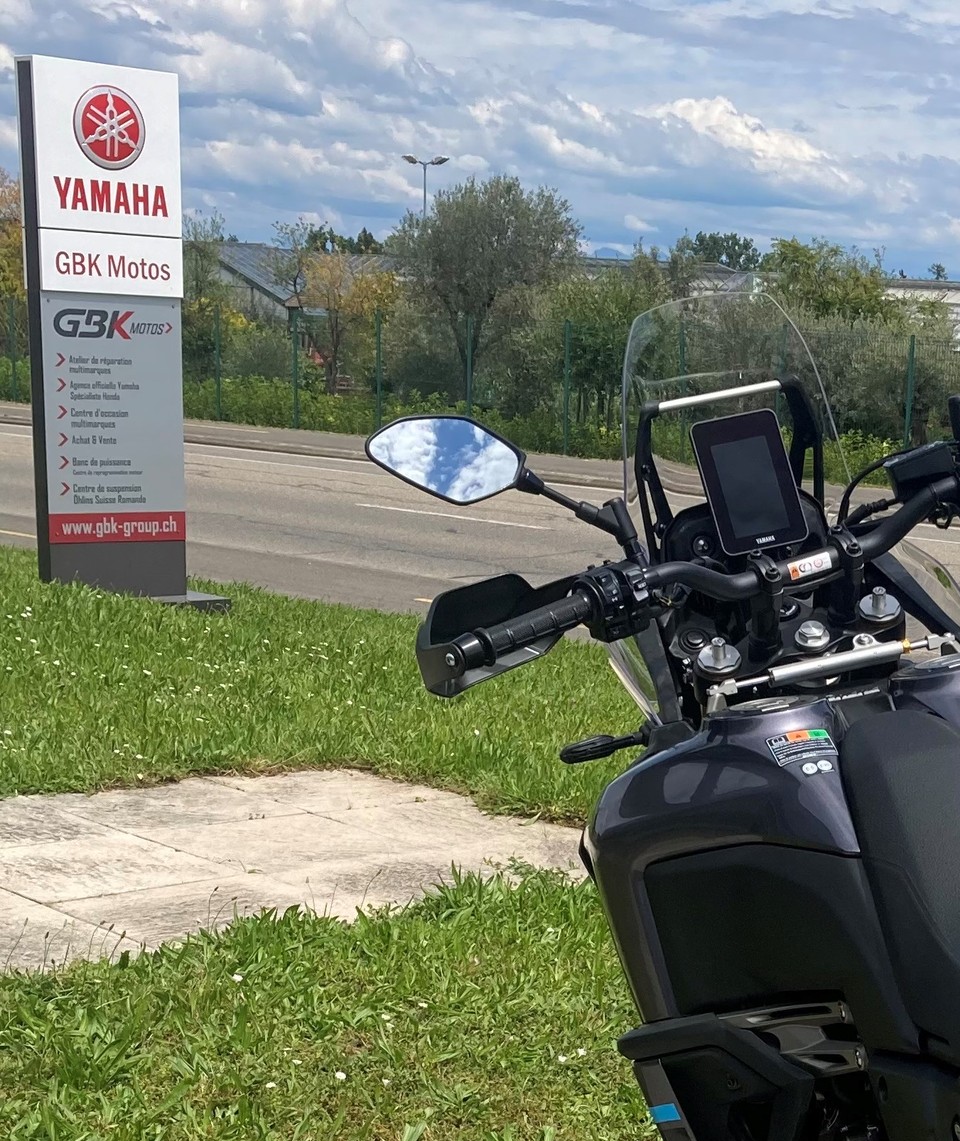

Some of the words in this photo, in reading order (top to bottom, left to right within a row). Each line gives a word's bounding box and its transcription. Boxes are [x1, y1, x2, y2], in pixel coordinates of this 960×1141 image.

[53, 176, 169, 217] YAMAHA
[55, 251, 101, 277] GBK
[107, 255, 171, 281] Motos
[53, 308, 135, 340] GBK
[129, 322, 165, 335] MOTOS
[69, 355, 89, 364] Atelier
[91, 355, 99, 364] de
[69, 365, 111, 375] multimarques
[70, 380, 91, 390] Agence
[92, 380, 116, 390] officielle
[118, 381, 140, 390] Yamaha
[103, 392, 120, 401] Honda
[71, 407, 93, 417] Centre
[95, 408, 129, 418] d'occasion
[71, 419, 116, 429] multimarques
[72, 435, 90, 444] Achat
[99, 435, 117, 445] Vente
[72, 457, 89, 466] Banc
[90, 457, 98, 466] de
[100, 458, 131, 468] puissance
[73, 484, 95, 493] Centre
[97, 484, 105, 493] de
[106, 484, 142, 493] suspension
[95, 495, 116, 504] Suisse
[62, 515, 177, 538] www.gbk-group.ch
[755, 534, 776, 545] YAMAHA
